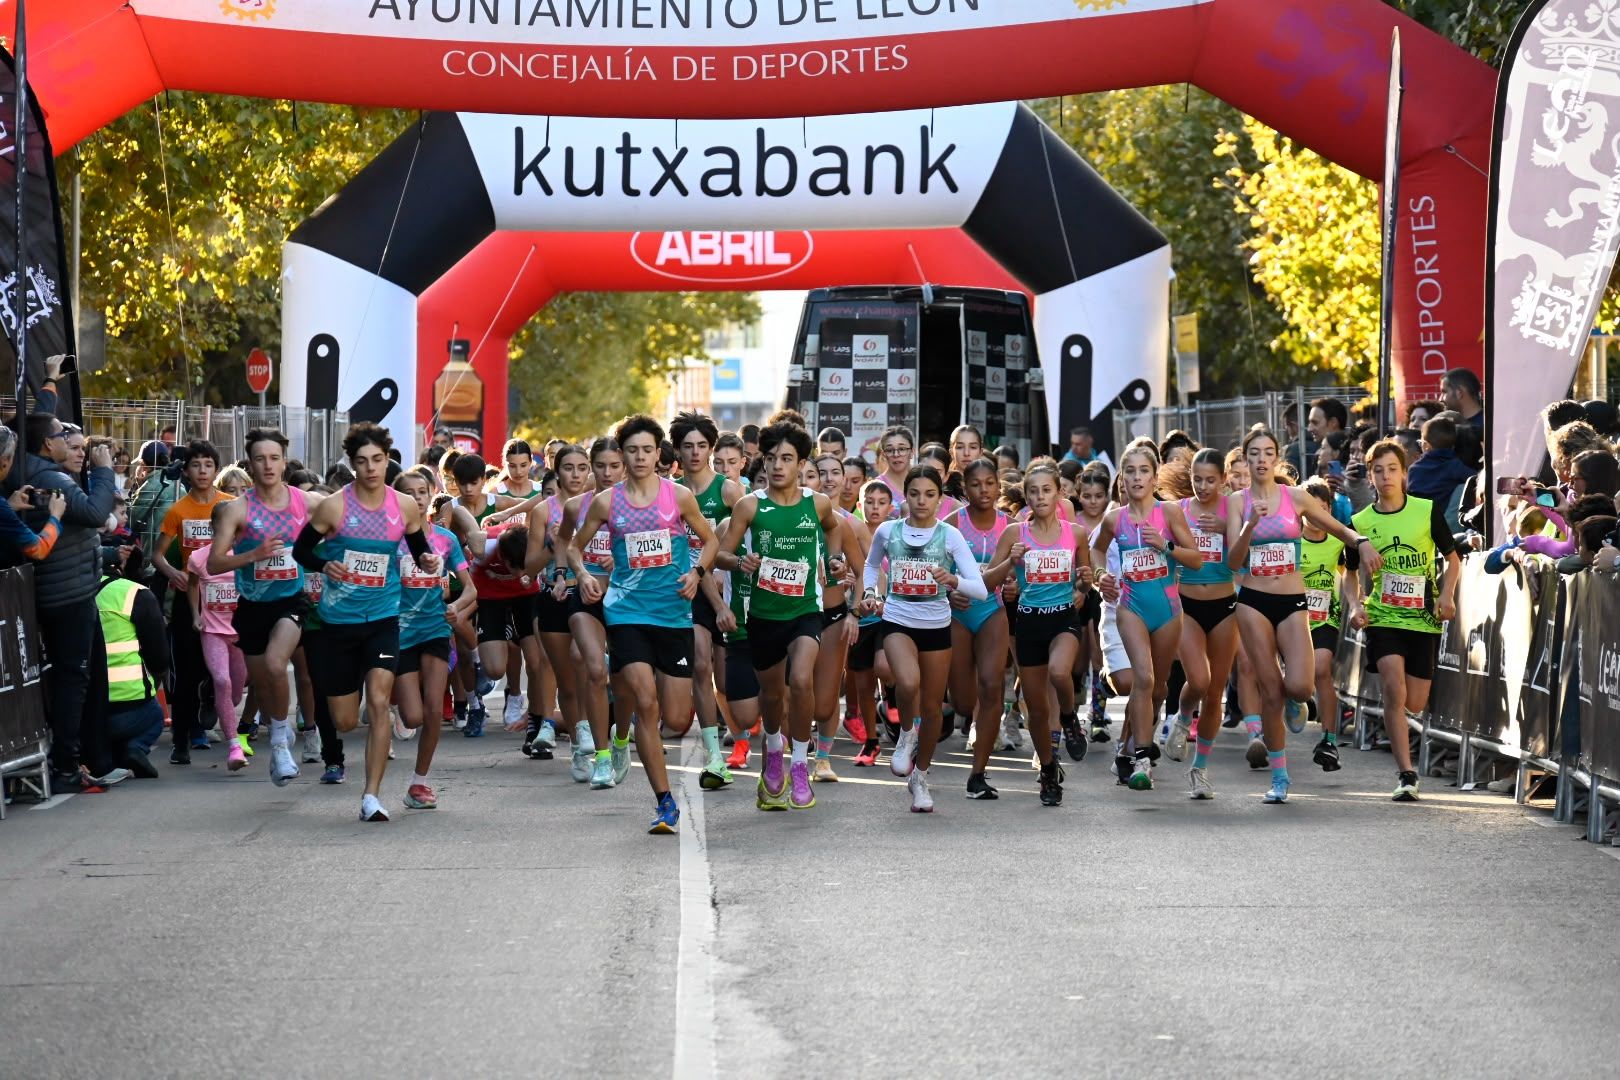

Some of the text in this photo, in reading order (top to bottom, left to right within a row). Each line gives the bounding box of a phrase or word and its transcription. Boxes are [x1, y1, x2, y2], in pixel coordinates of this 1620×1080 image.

[368, 0, 758, 29] AYUNTAMIENTO
[778, 0, 837, 26] DE
[442, 44, 909, 84] CONCEJALÍA DE DEPORTES
[514, 125, 959, 197] kutxabank
[655, 231, 791, 266] ABRIL
[1410, 195, 1448, 375] DEPORTES
[249, 365, 268, 376] STOP
[192, 526, 213, 536] 2035
[636, 539, 663, 553] 2034
[267, 555, 285, 566] 2115
[1037, 557, 1059, 569] 2051
[1132, 554, 1156, 568] 2079
[1260, 550, 1285, 563] 2098
[354, 559, 378, 573] 2025
[771, 566, 797, 581] 2023
[901, 568, 927, 580] 2048
[215, 589, 238, 599] 2083
[1391, 581, 1414, 594] 2026
[1307, 596, 1323, 608] 027
[1037, 605, 1067, 615] NIKE
